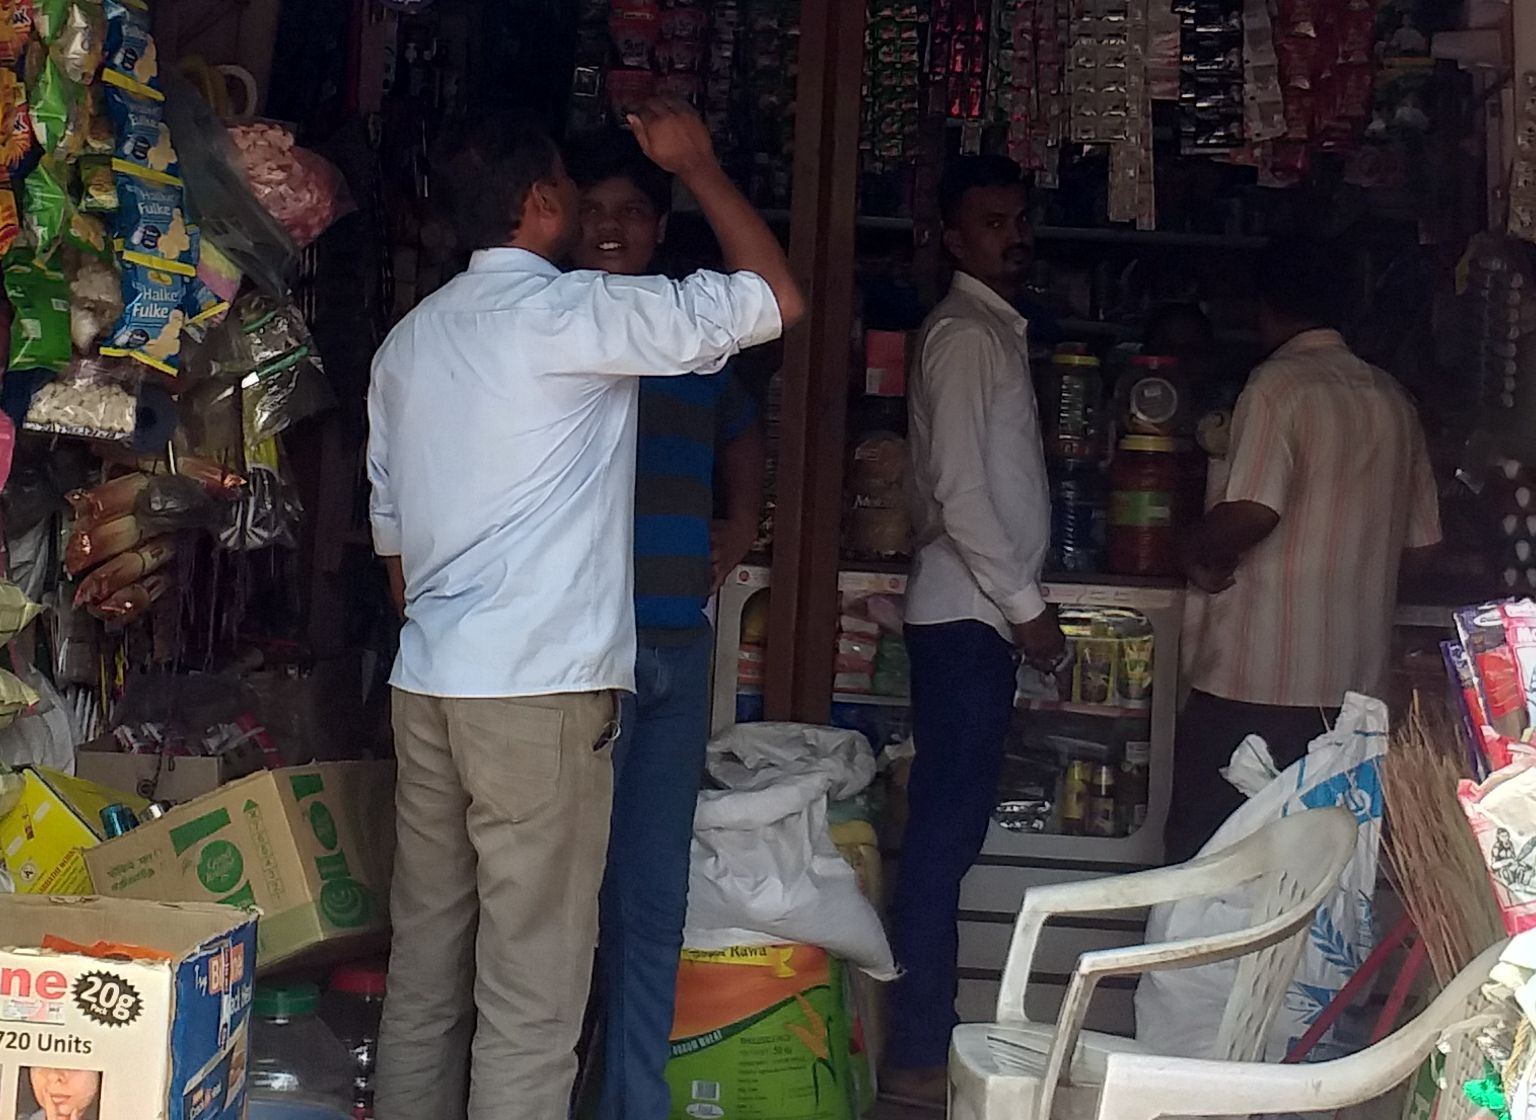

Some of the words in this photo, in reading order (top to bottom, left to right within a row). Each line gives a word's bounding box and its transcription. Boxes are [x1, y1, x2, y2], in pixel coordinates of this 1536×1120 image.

[137, 201, 171, 216] Fulke
[132, 302, 169, 319] Fulke
[80, 975, 135, 1022] 20g
[37, 1033, 93, 1055] Units
[699, 1030, 723, 1051] WHEAT
